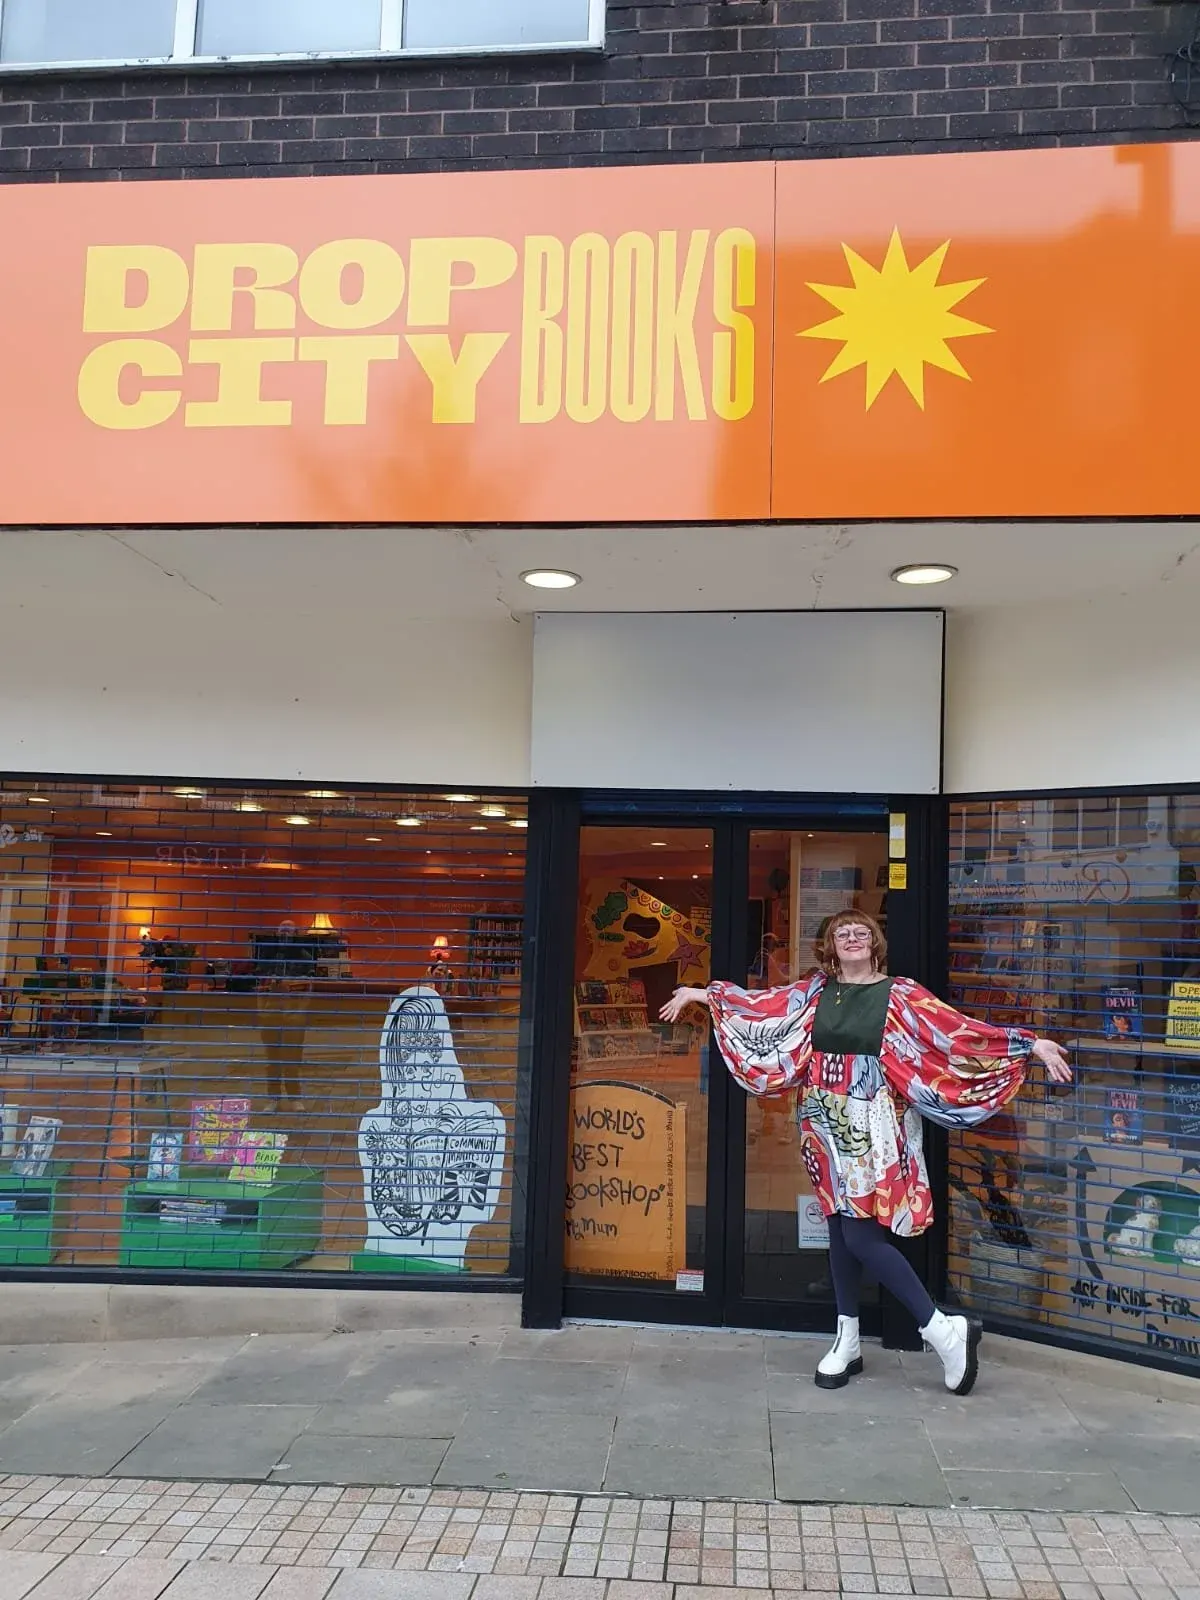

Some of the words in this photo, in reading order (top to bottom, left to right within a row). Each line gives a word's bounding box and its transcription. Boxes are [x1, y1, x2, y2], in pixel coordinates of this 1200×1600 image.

[82, 237, 518, 333] DROP
[519, 227, 756, 424] BOOKS
[77, 332, 511, 430] CITY
[1105, 997, 1138, 1008] DEVIL
[571, 1142, 624, 1172] BEST
[1071, 1279, 1099, 1309] ASK
[1106, 1284, 1152, 1318] INSIDE
[1156, 1288, 1200, 1324] FOR
